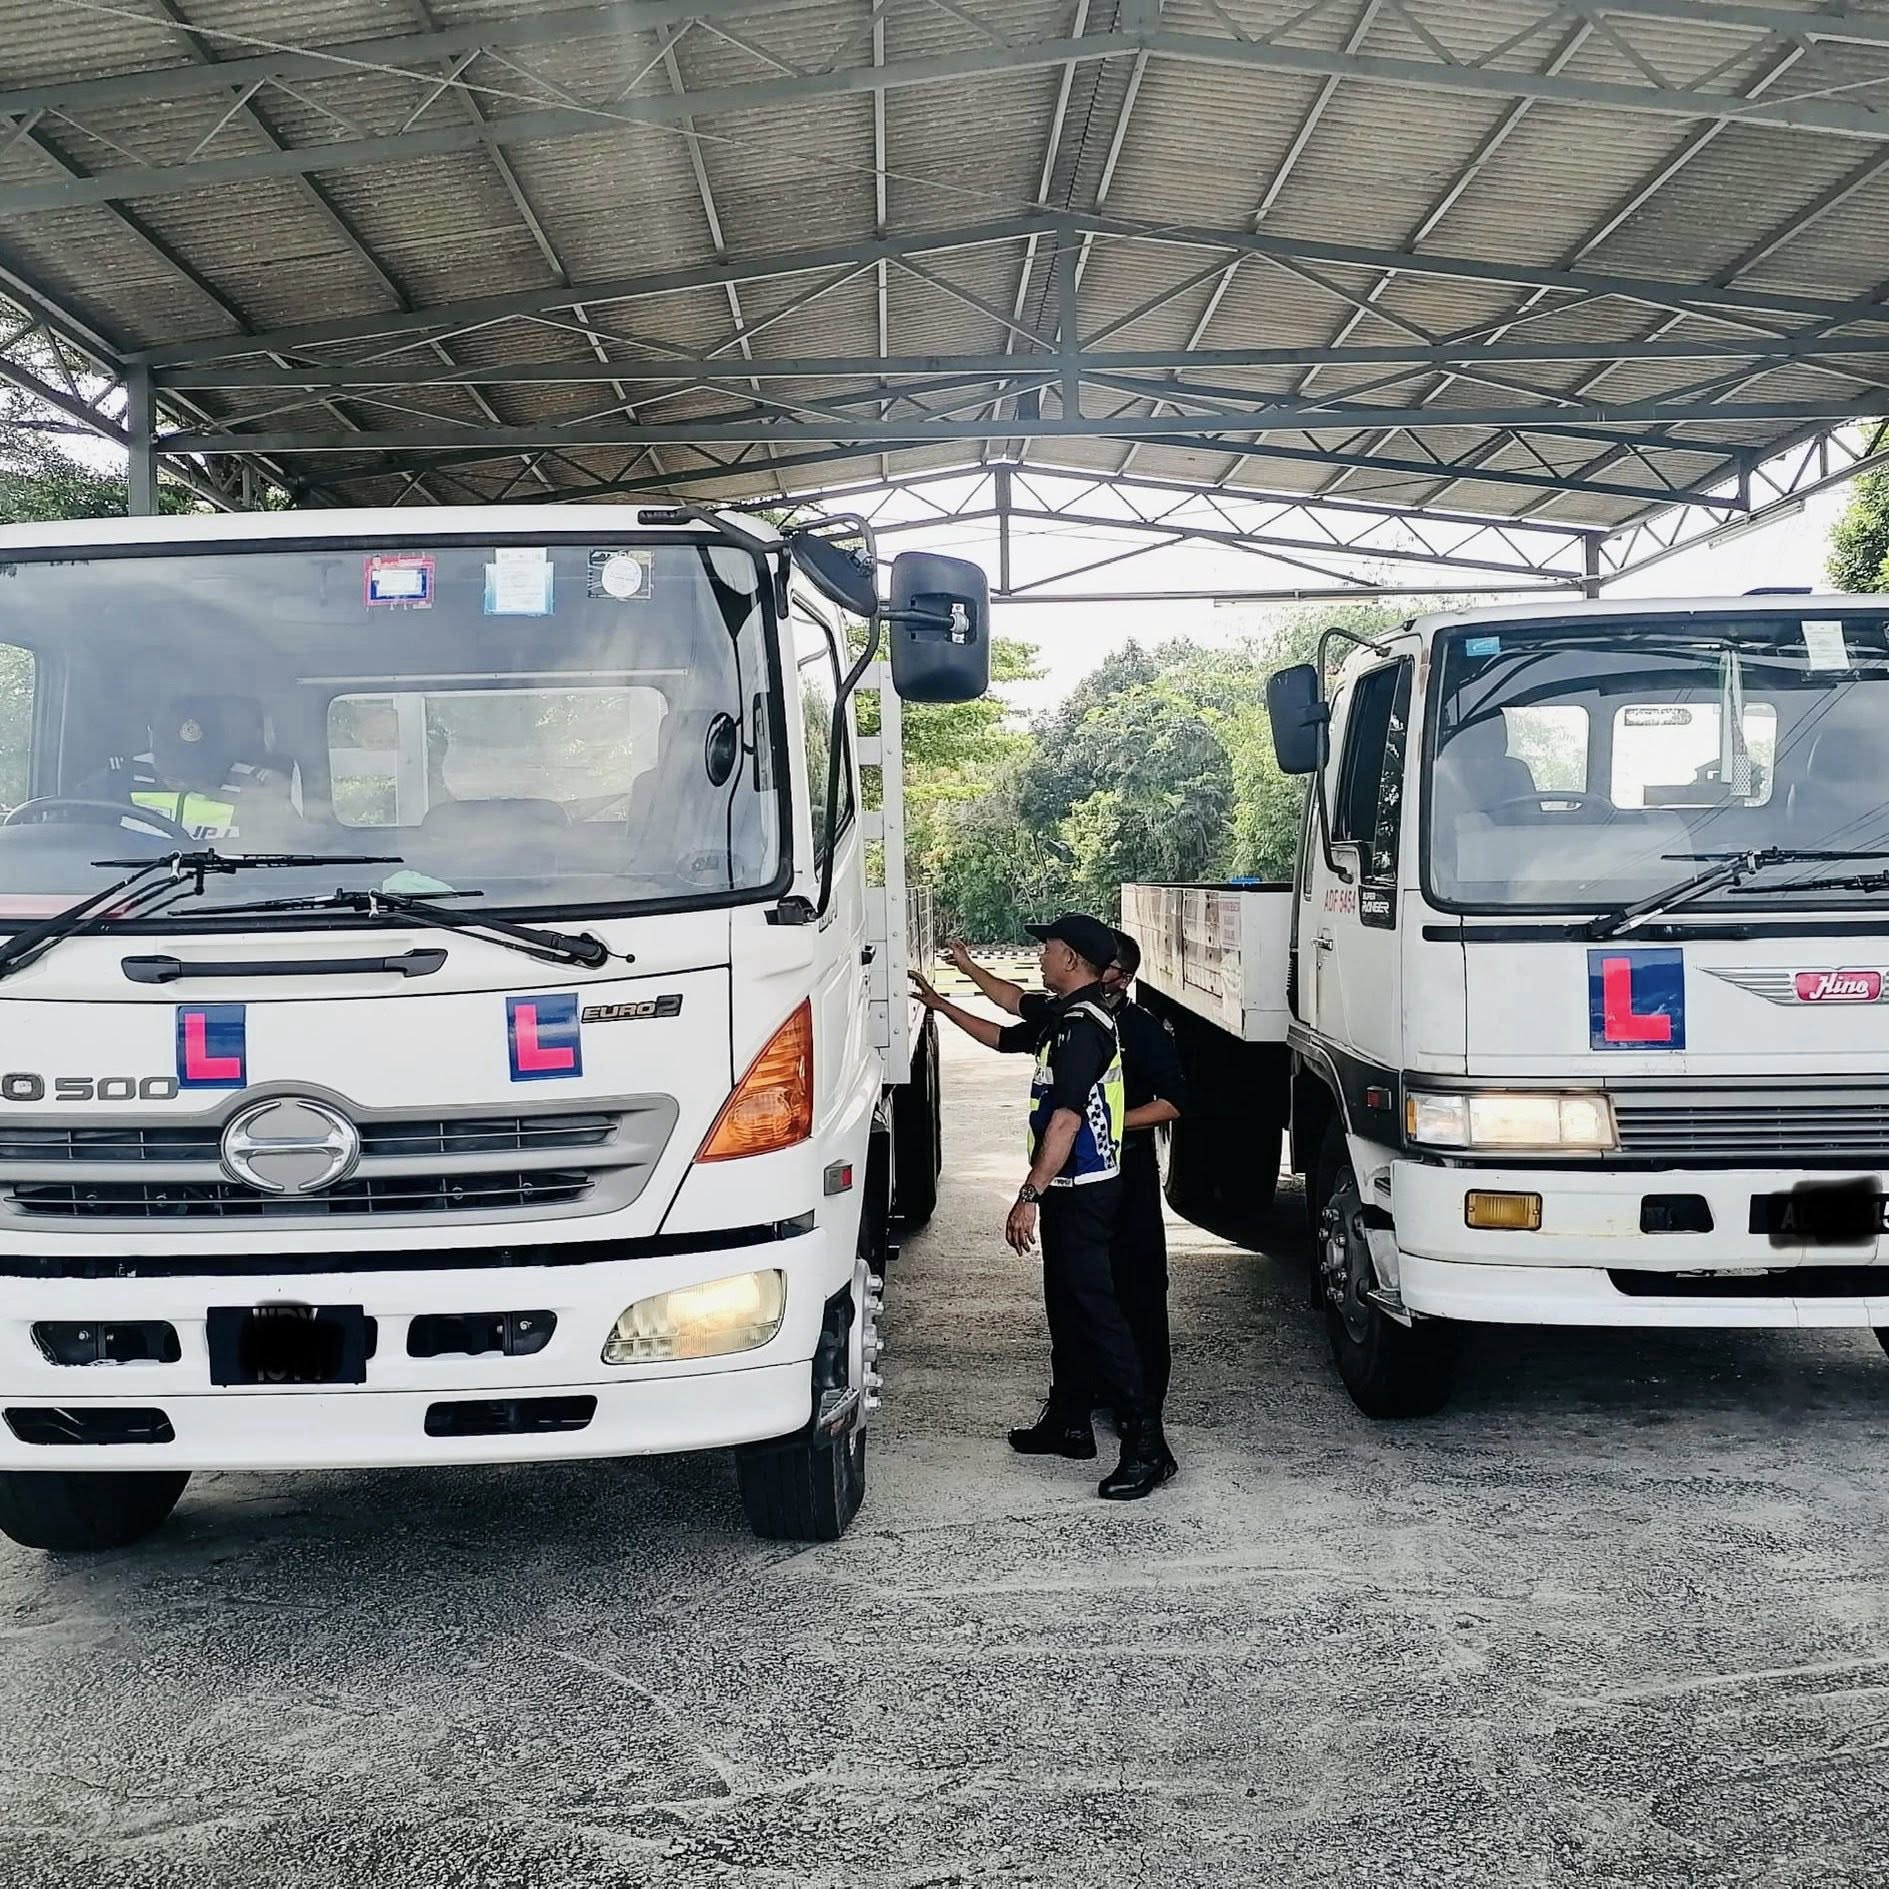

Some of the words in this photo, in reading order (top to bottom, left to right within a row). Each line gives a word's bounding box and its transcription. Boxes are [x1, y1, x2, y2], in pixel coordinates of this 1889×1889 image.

[1602, 957, 1672, 1042] L
[1809, 974, 1869, 1000] Hino
[184, 1012, 242, 1080] L
[514, 1004, 575, 1072] L
[55, 1076, 179, 1101] 500
